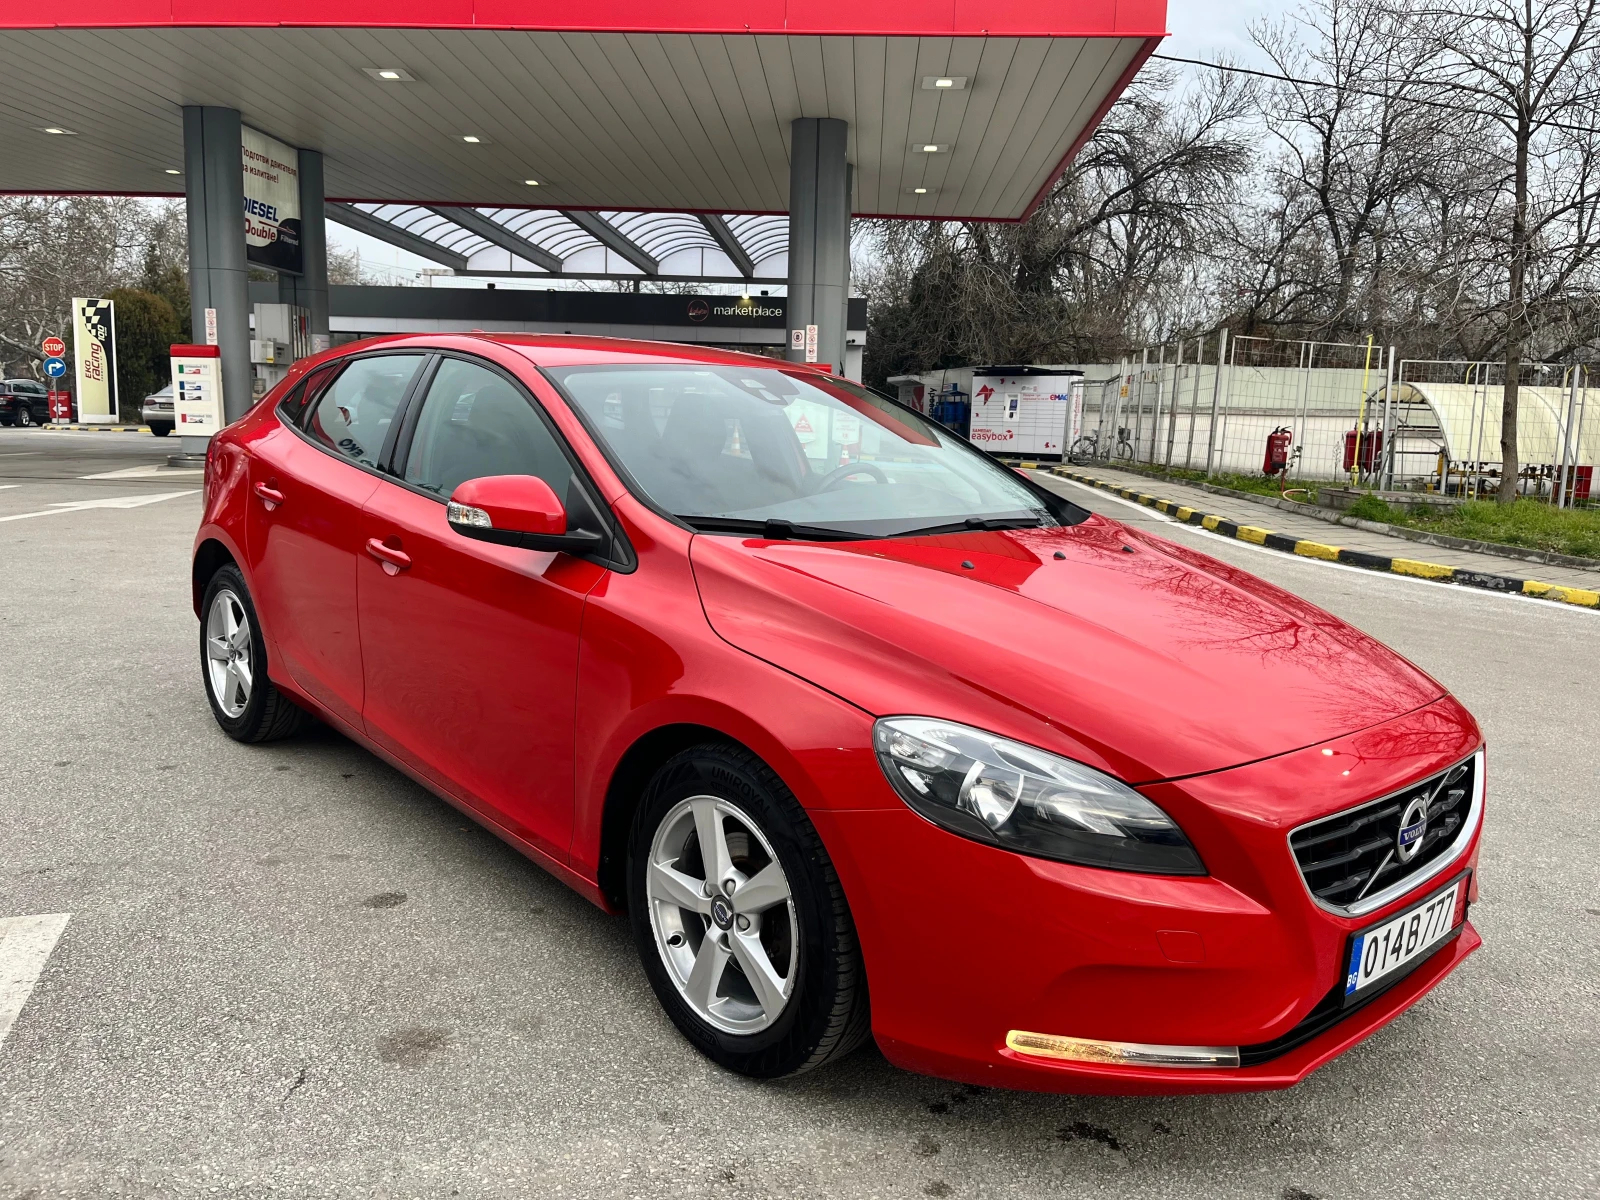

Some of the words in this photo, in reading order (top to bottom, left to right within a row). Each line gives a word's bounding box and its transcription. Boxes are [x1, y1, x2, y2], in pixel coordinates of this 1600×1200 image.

[250, 166, 279, 184] излитане!
[270, 159, 297, 177] двигателя
[245, 217, 277, 241] Double
[713, 304, 783, 319] marketplace
[97, 324, 106, 342] 100
[44, 343, 63, 352] STOP
[84, 360, 92, 379] EKO
[91, 342, 102, 382] racing
[971, 432, 1008, 443] easybox
[711, 765, 772, 817] UNIROYAL
[1364, 889, 1455, 979] 014B777
[1346, 971, 1358, 988] BG
